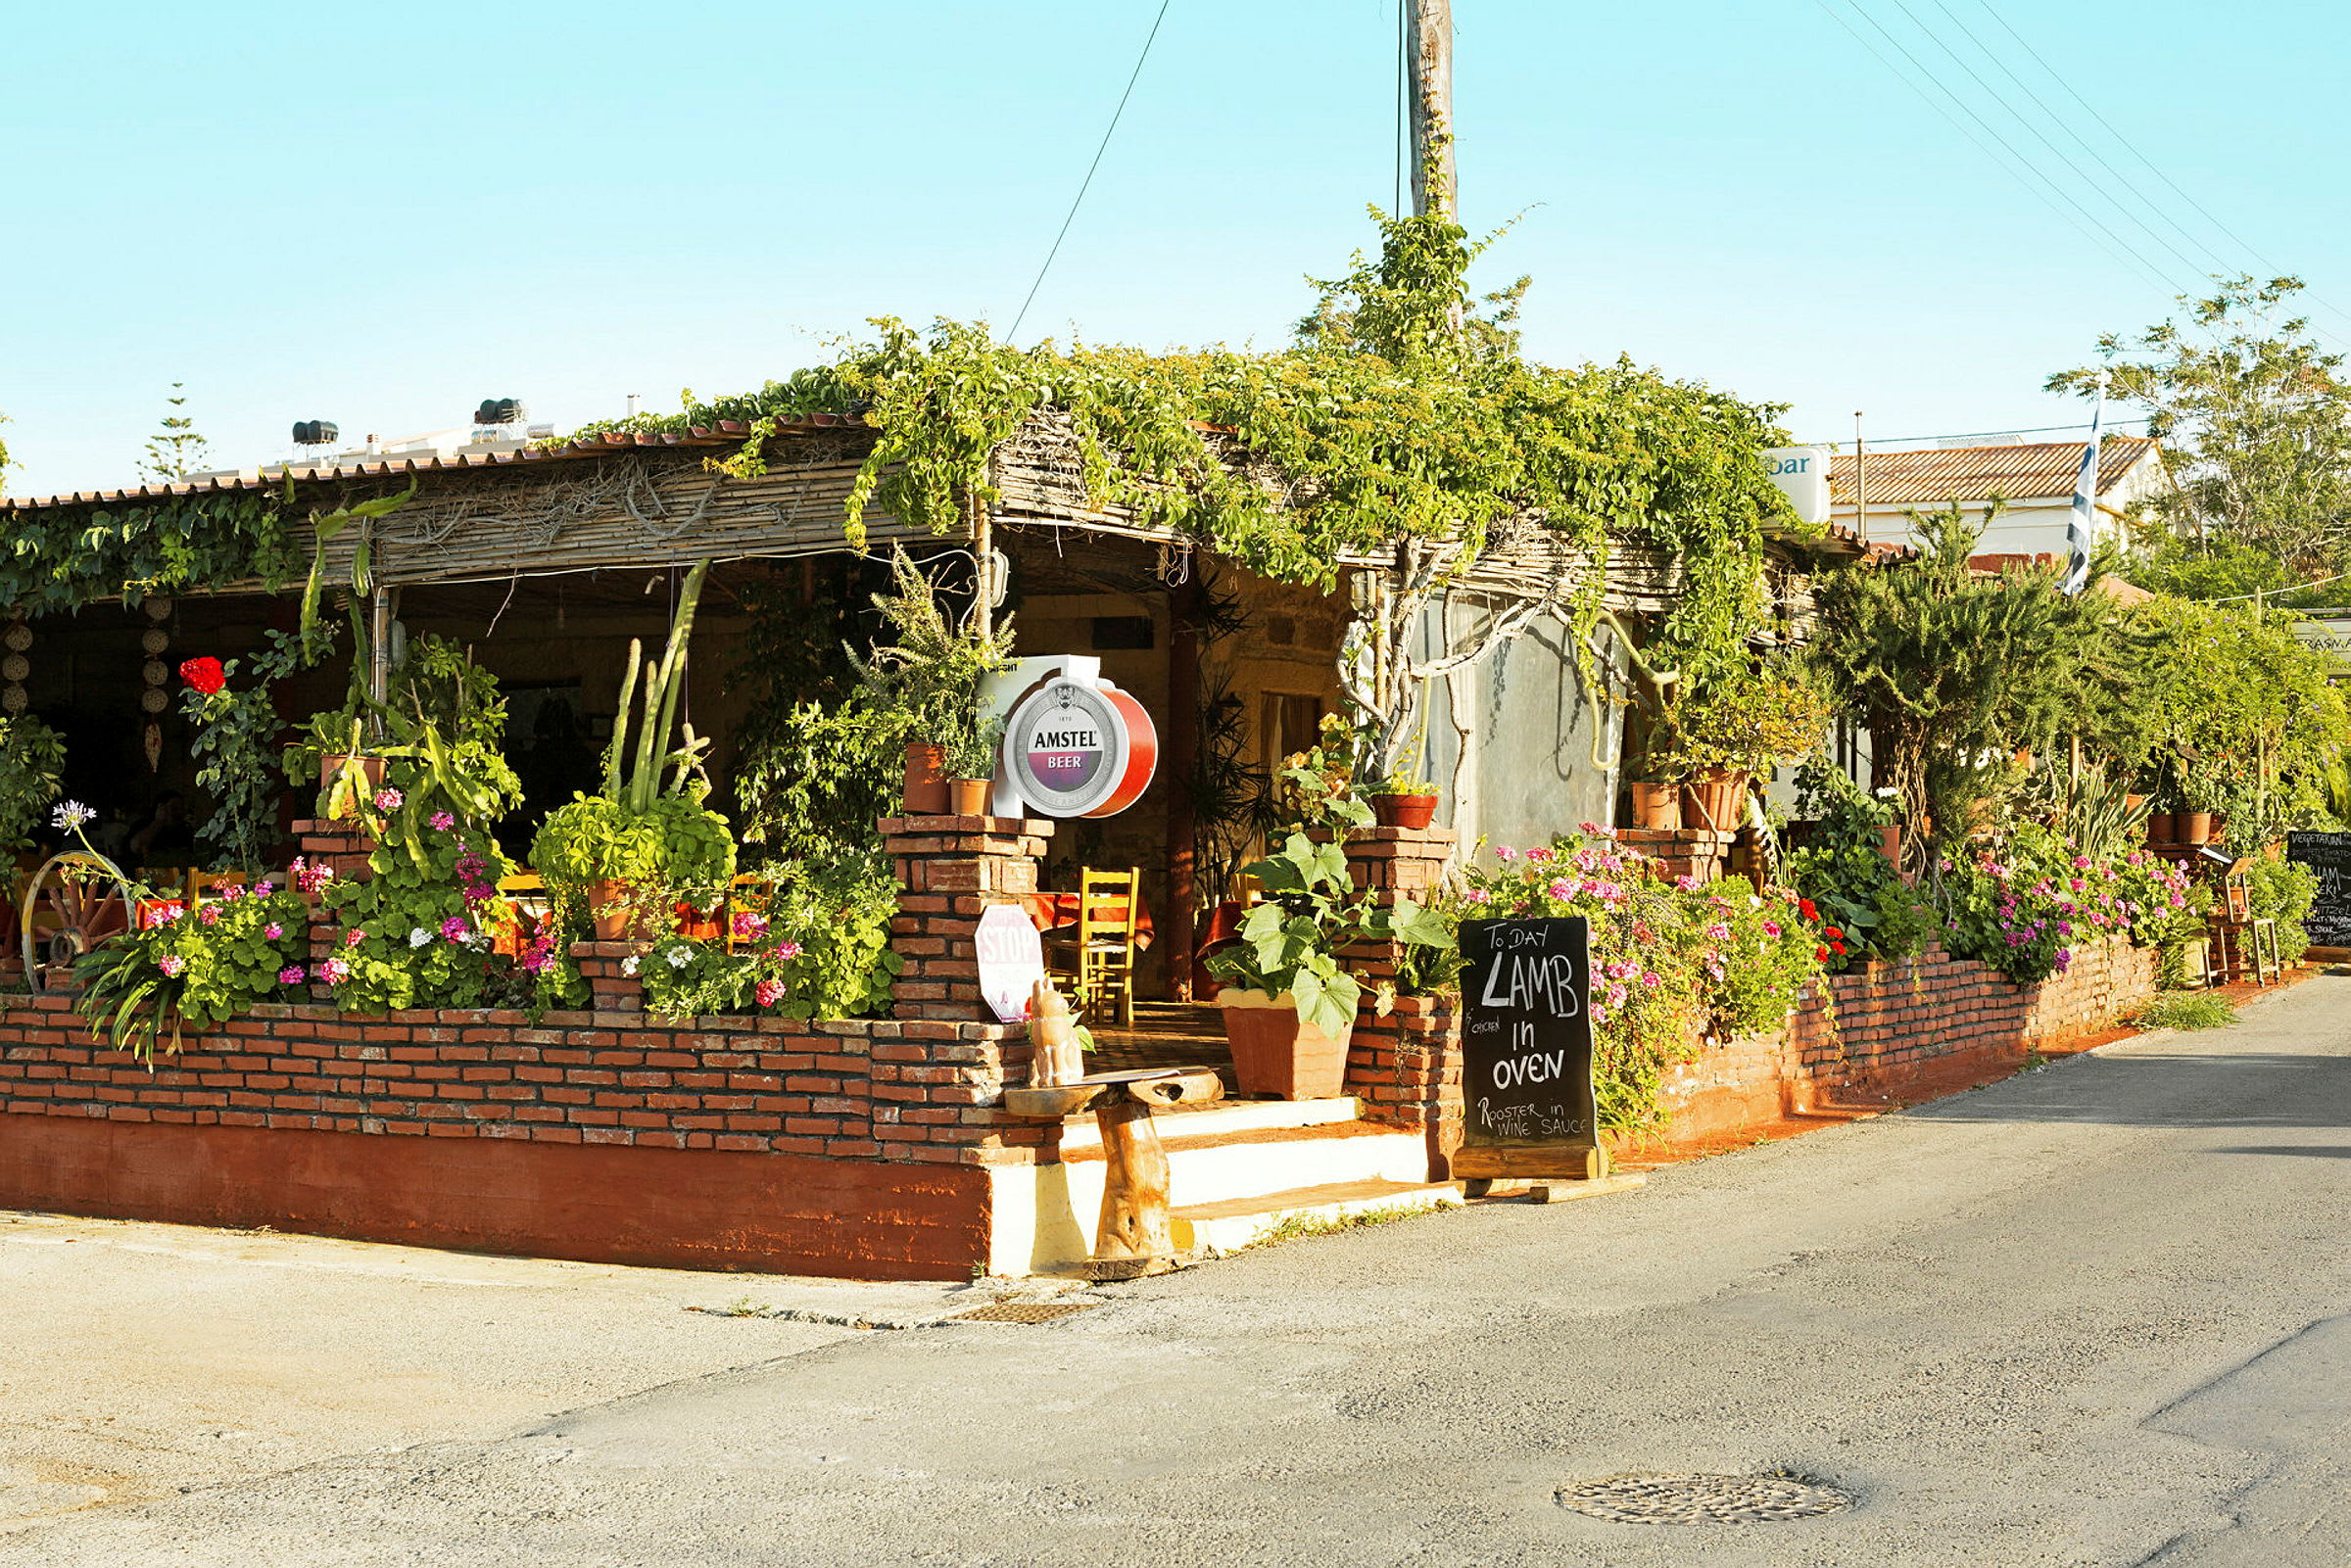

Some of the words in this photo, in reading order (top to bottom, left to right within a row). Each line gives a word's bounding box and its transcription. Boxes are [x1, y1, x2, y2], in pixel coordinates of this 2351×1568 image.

[1034, 731, 1095, 748] AMSTEL
[1047, 756, 1081, 769] BEER
[982, 926, 1033, 962] STOP
[1481, 951, 1578, 1018] LAMB
[1493, 1049, 1564, 1090] OVEN
[1477, 1096, 1543, 1128] ROOSTER
[1541, 1118, 1588, 1135] SAUCE
